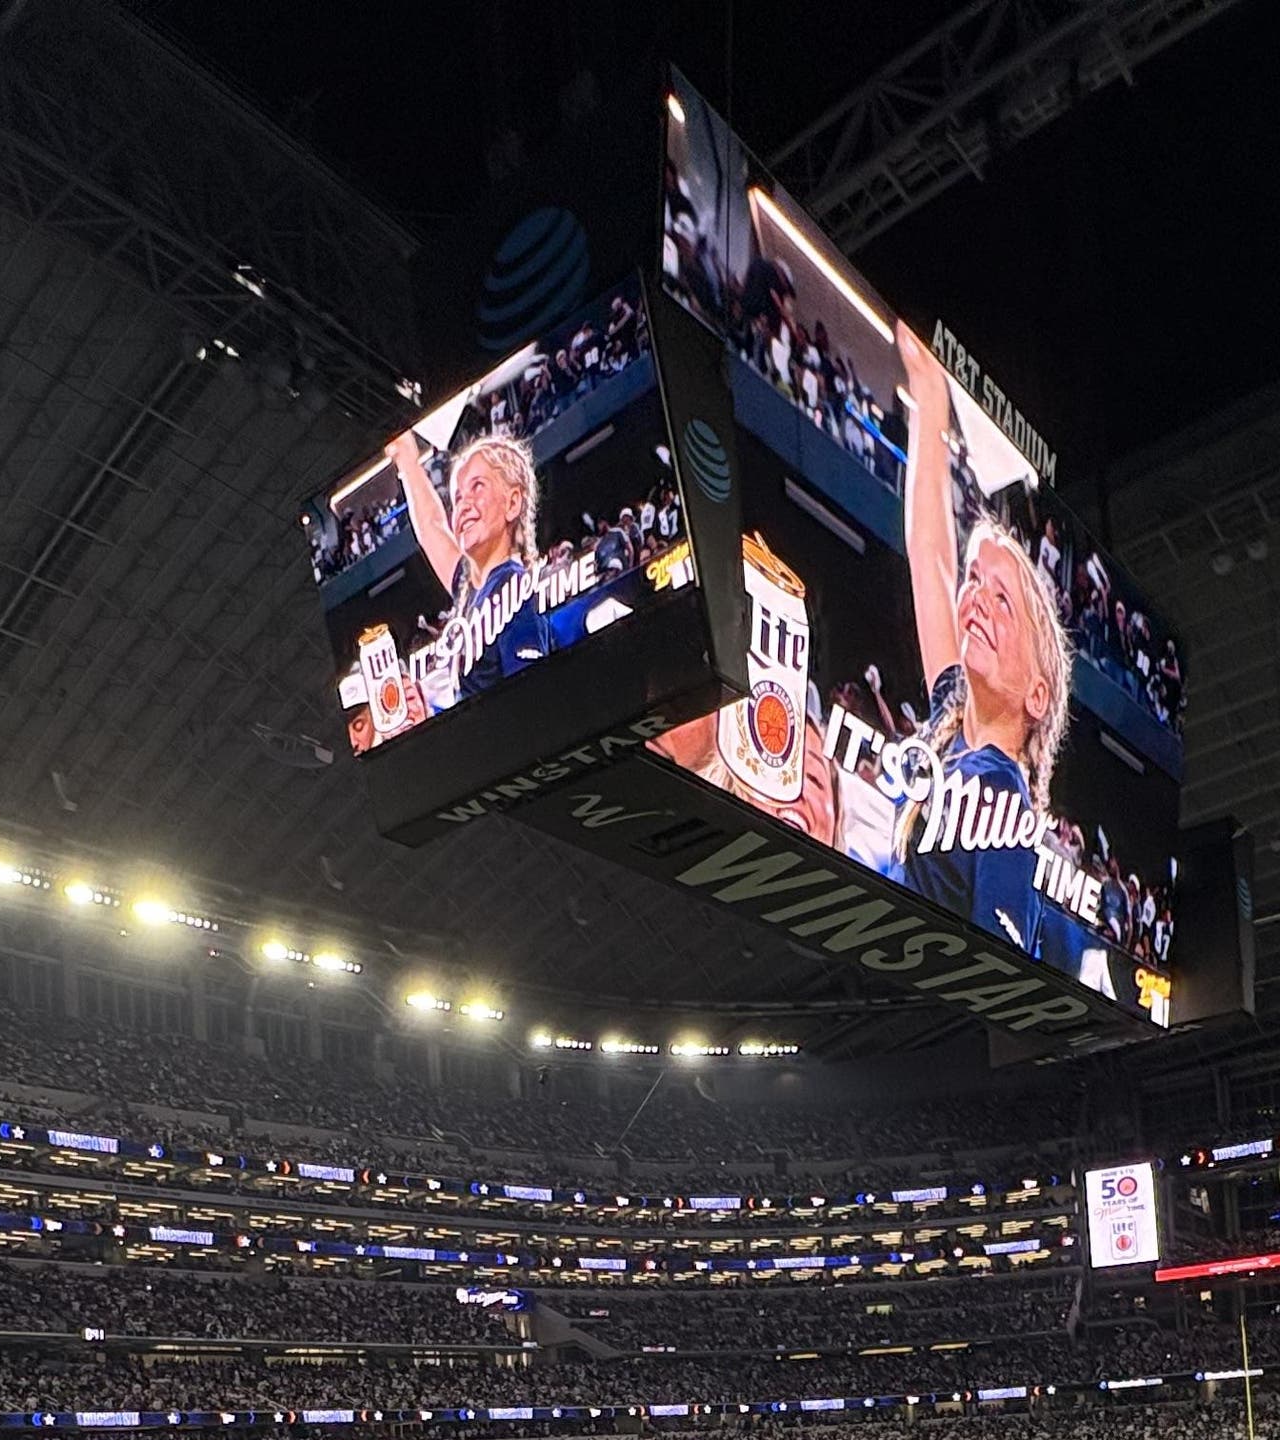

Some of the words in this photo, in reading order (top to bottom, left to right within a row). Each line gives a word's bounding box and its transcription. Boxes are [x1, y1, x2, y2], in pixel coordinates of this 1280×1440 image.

[932, 318, 980, 398] AT&T
[982, 373, 1058, 488] STADIUM
[410, 636, 451, 684] IT'S
[442, 557, 547, 677] Miller
[536, 551, 598, 615] TIME
[437, 713, 677, 823] WINSTAR
[823, 704, 904, 798] IT'S
[898, 737, 1058, 854] Miller
[1032, 844, 1102, 926] TIME
[675, 831, 1090, 1033] WINSTAR
